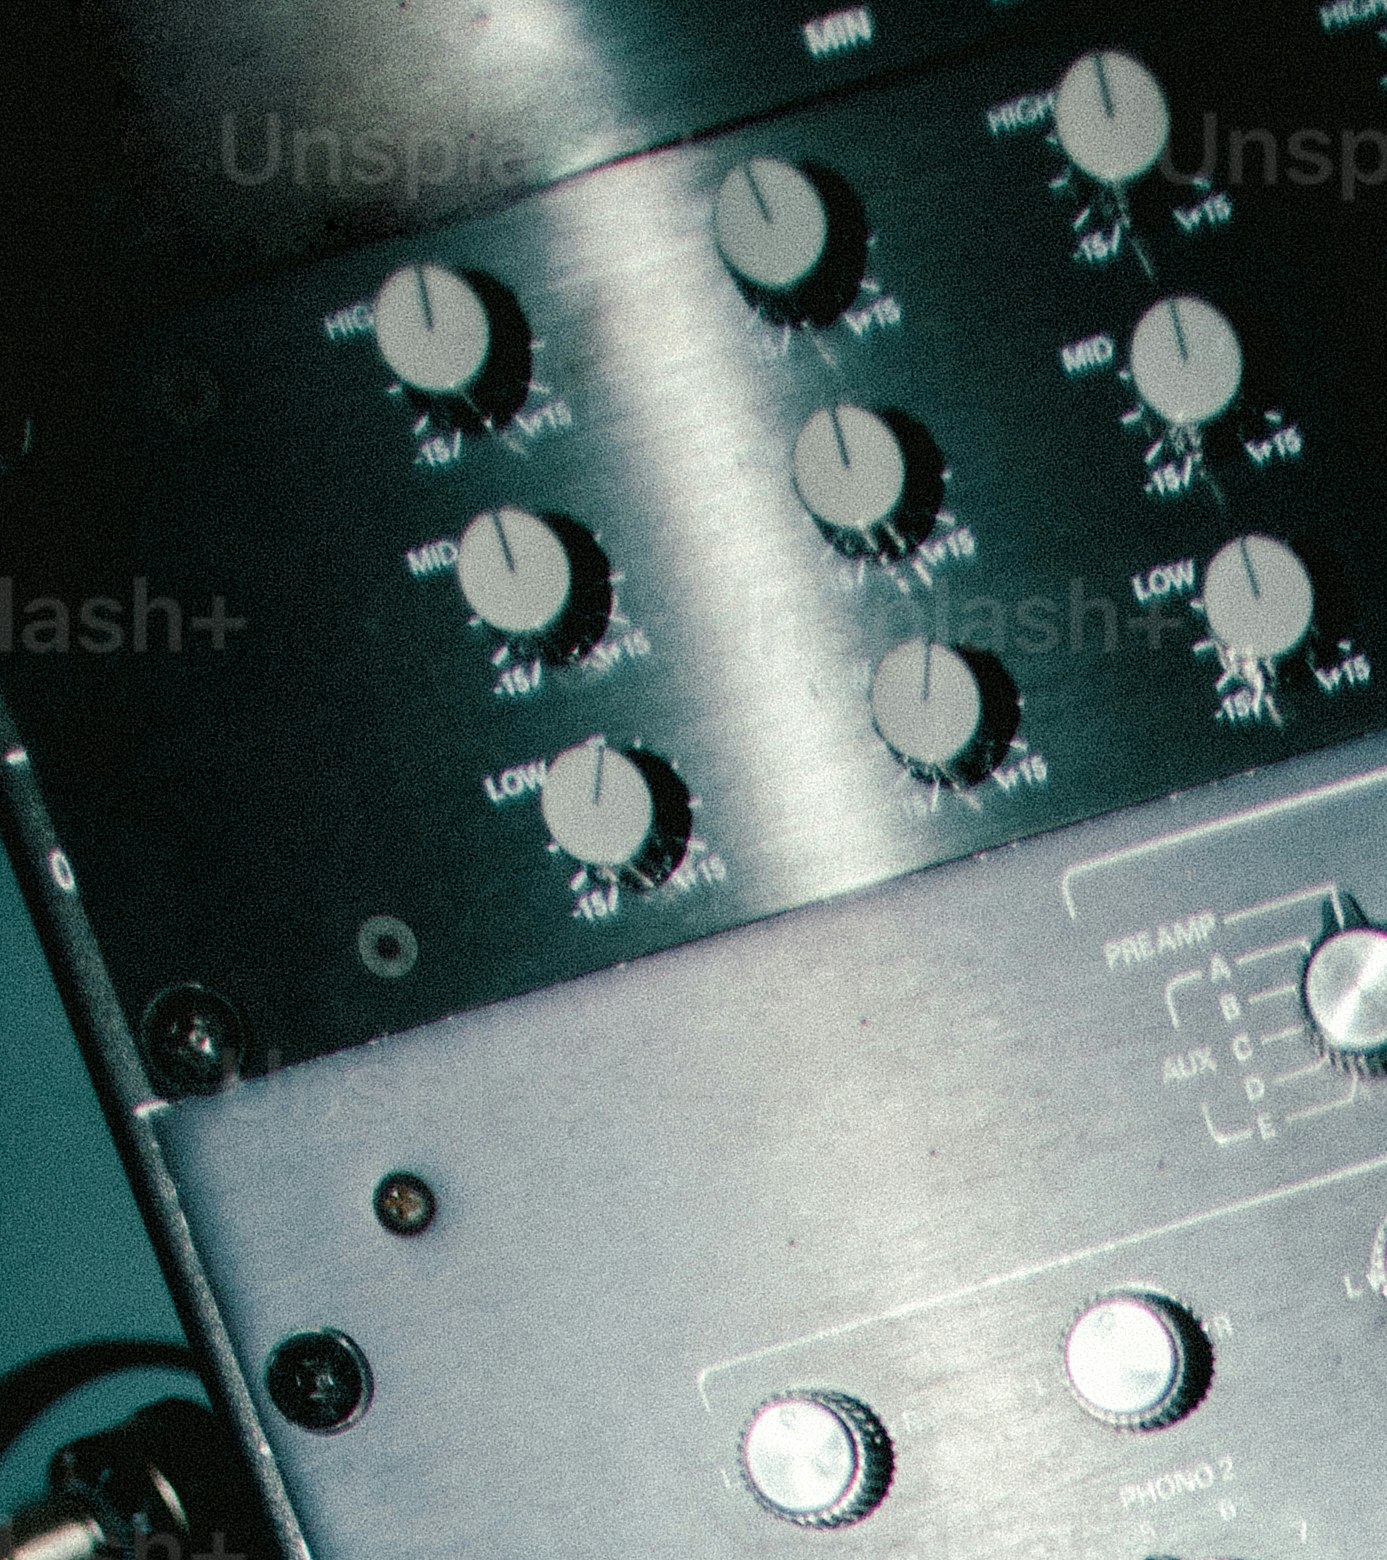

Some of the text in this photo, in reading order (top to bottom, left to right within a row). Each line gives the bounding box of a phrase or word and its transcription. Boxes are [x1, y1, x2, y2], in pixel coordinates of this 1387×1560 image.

[804, 8, 873, 57] MIN
[1061, 334, 1115, 375] MID
[407, 538, 458, 577] MID
[1132, 560, 1197, 602] LOW
[483, 759, 549, 802] LOW
[1105, 916, 1216, 967] PREAMP
[1211, 956, 1231, 981] A
[1162, 1050, 1214, 1083] AUX
[1119, 1465, 1216, 1507] PHONO
